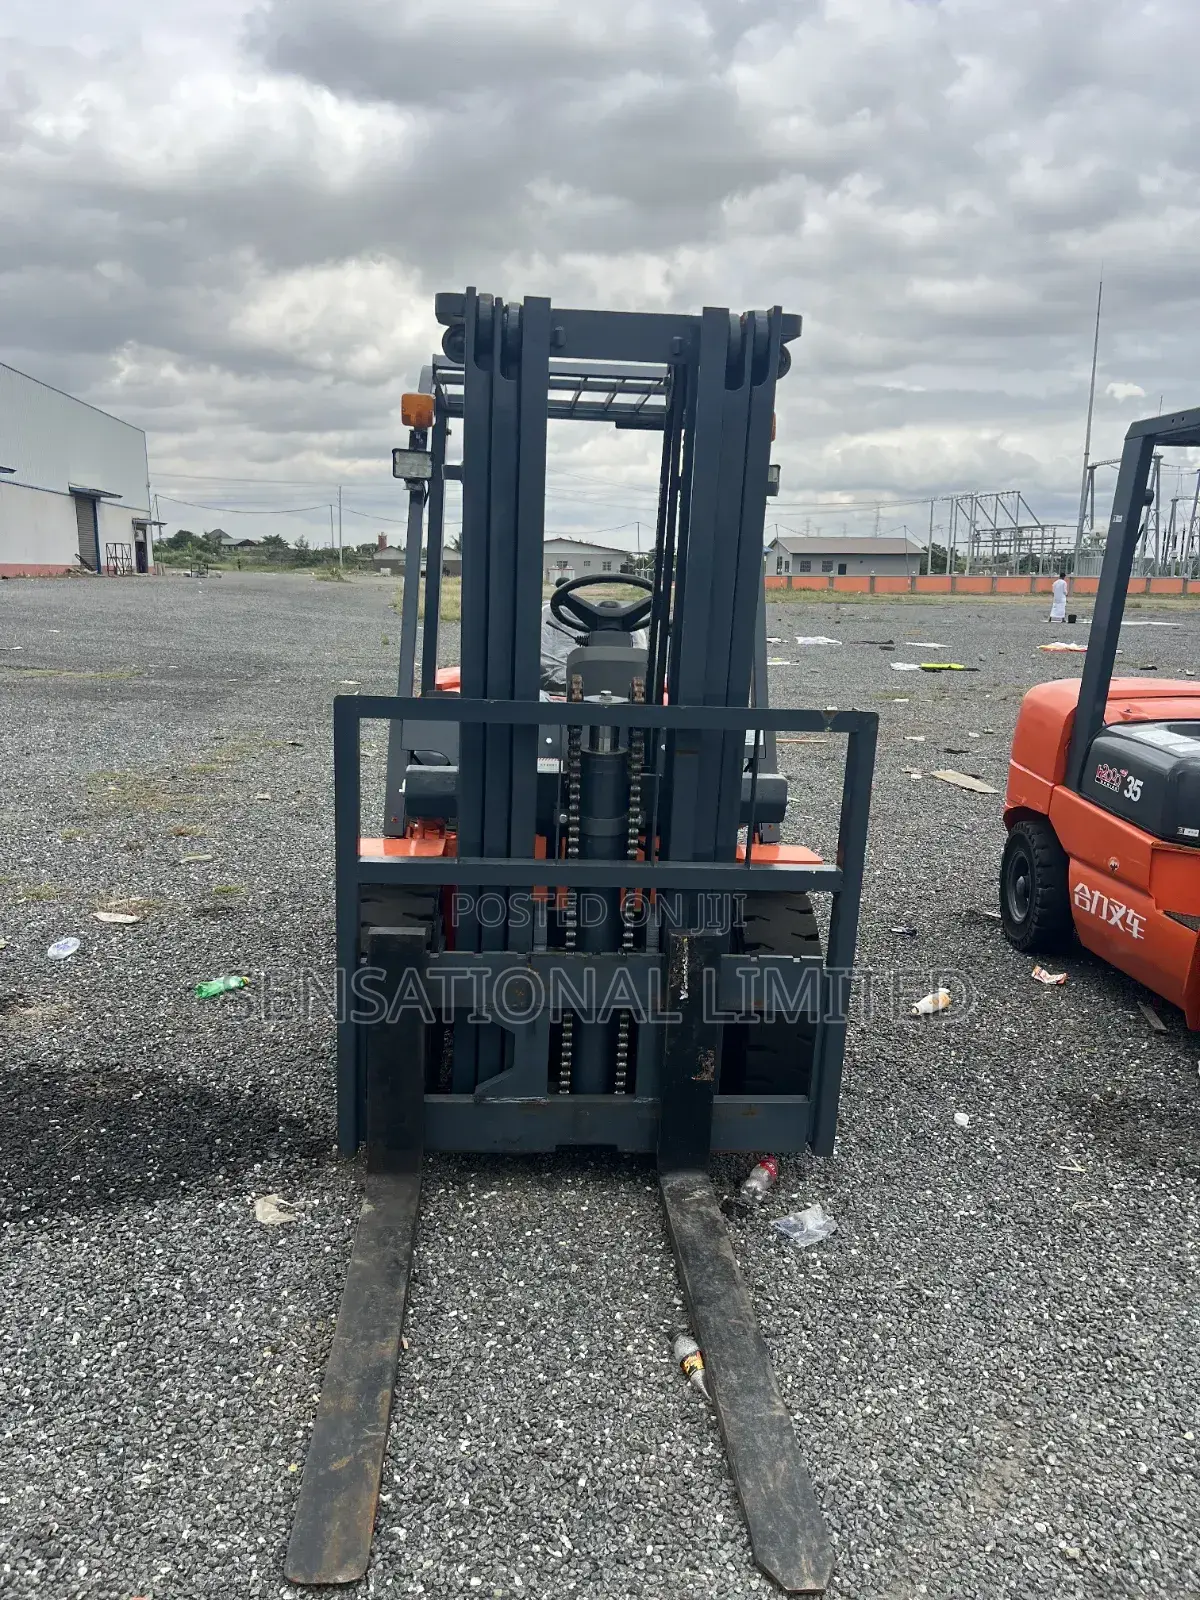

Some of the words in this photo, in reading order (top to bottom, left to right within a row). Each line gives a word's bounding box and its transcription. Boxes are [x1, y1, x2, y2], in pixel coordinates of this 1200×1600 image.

[1123, 775, 1144, 802] 35
[1073, 882, 1147, 940] 合力叉车
